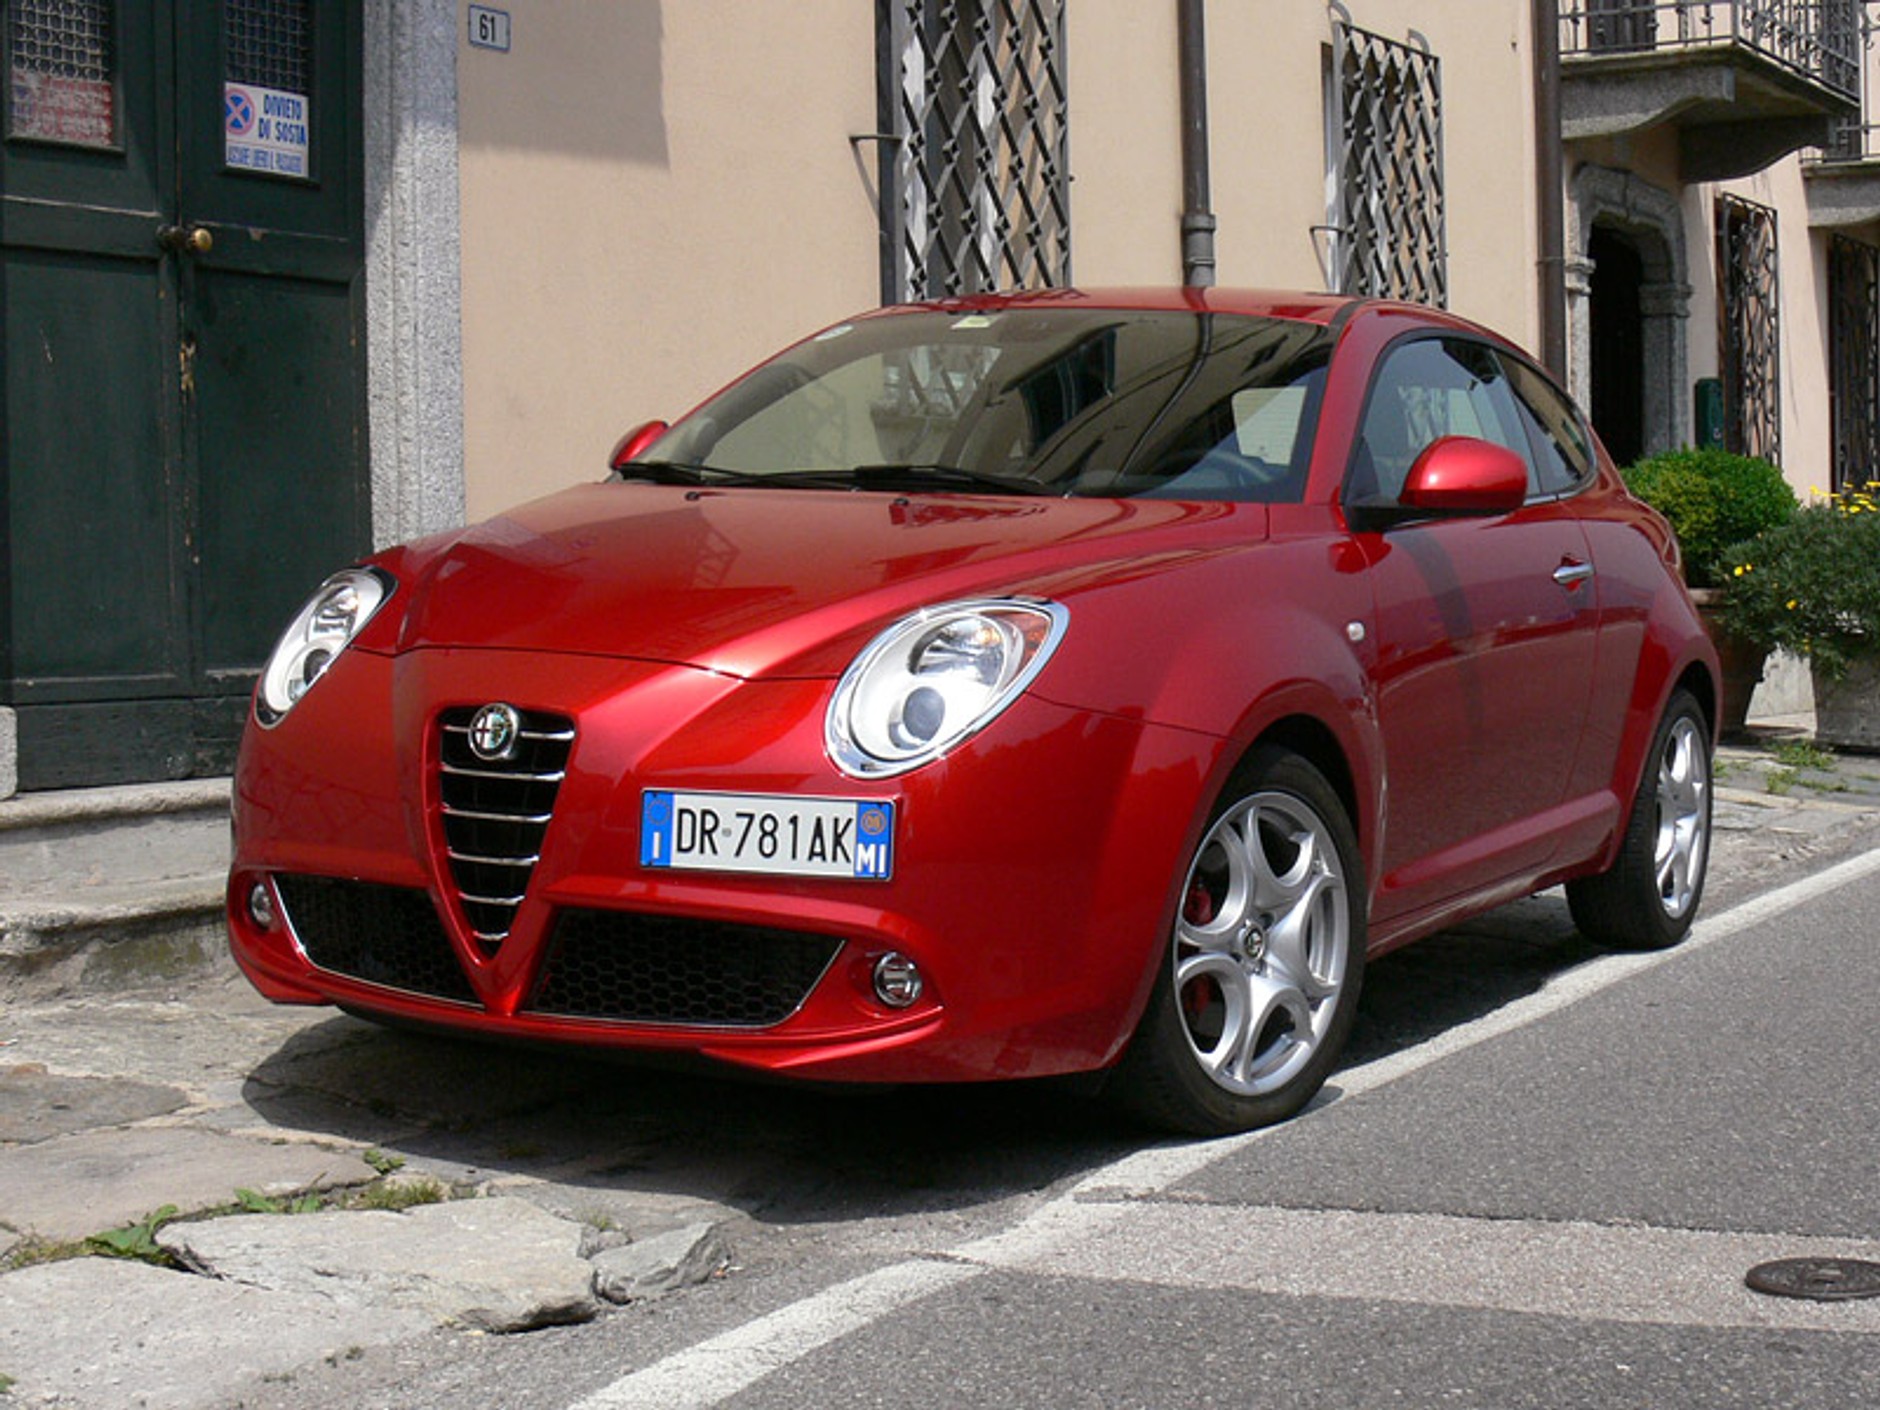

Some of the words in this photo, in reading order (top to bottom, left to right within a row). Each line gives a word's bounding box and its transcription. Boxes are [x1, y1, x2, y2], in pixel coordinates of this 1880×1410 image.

[479, 13, 496, 43] 61
[264, 94, 301, 120] DIVIETO
[258, 117, 271, 140] DI
[275, 122, 306, 145] SOSTA
[855, 842, 887, 873] MI
